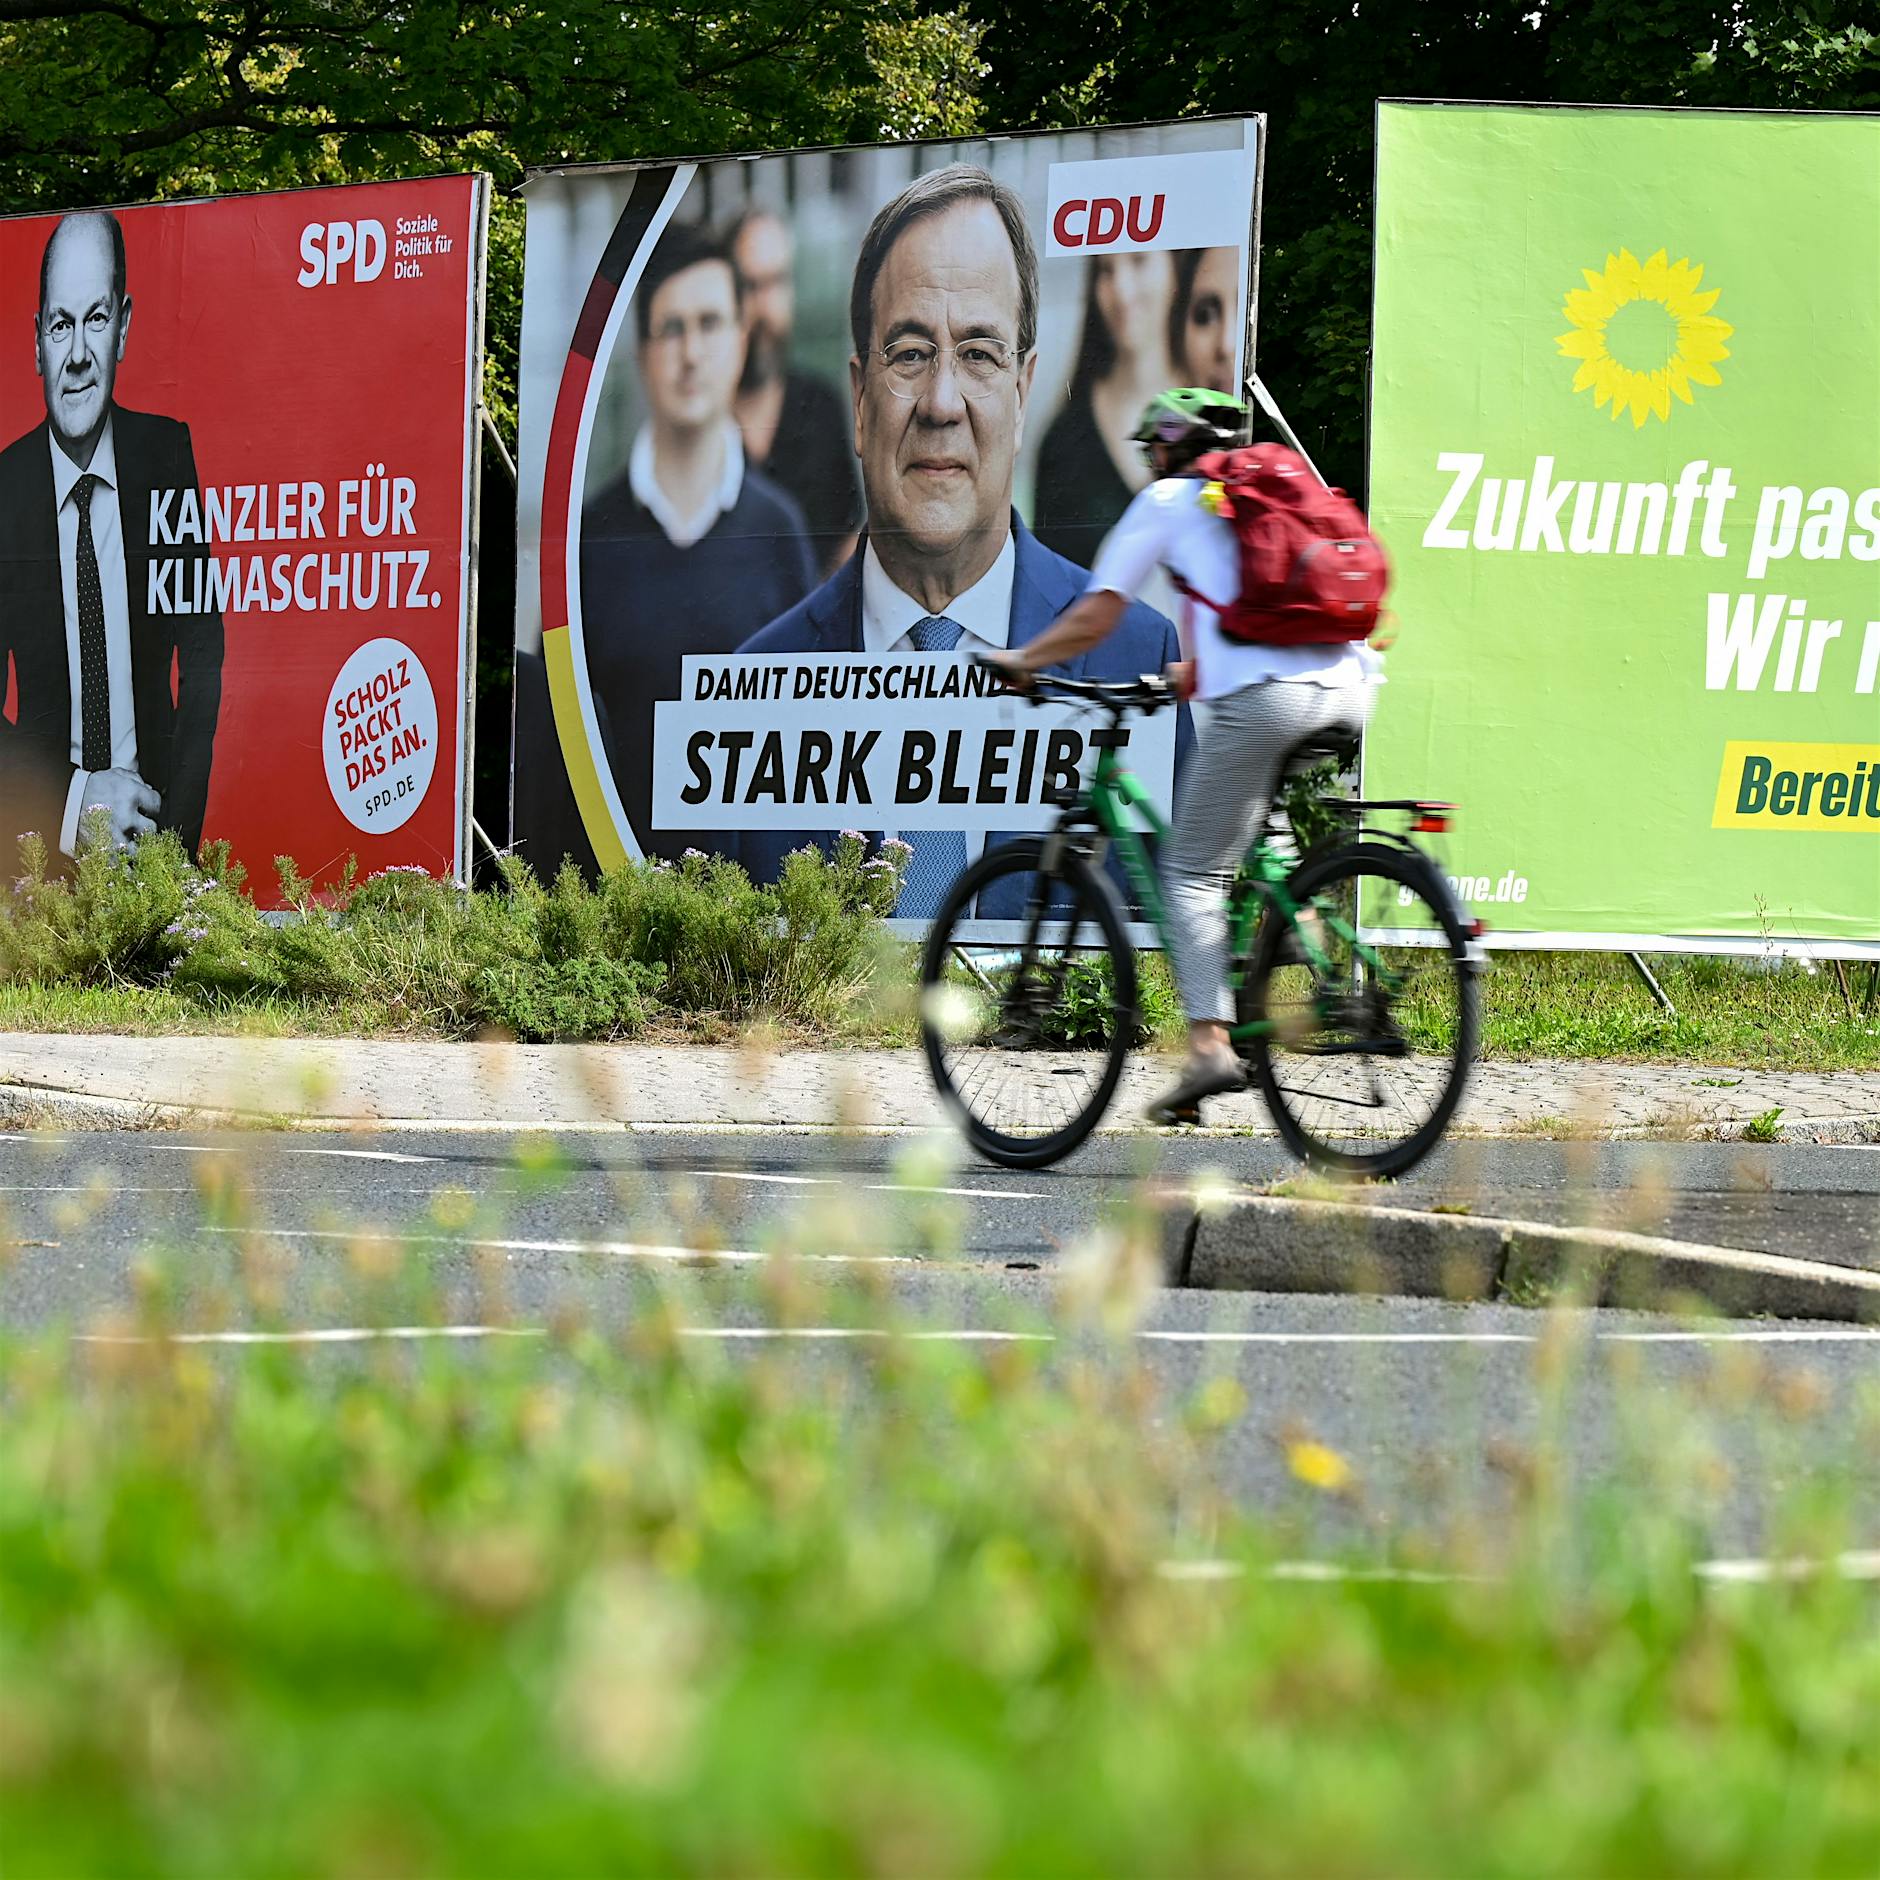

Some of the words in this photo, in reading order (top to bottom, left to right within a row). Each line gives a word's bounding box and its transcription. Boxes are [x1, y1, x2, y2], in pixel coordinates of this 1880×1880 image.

[297, 219, 387, 288] SPD
[395, 235, 432, 257] Politik
[434, 234, 453, 253] für
[396, 213, 438, 235] Soziale
[1053, 194, 1166, 248] CDU
[394, 259, 423, 280] Dich.
[148, 482, 326, 545] KANZLER
[337, 462, 417, 538] FÜR
[1422, 452, 1737, 557] Zukunft
[147, 550, 442, 615] KLIMASCHUTZ.
[1706, 592, 1842, 693] Wir
[334, 658, 411, 729] SCHOLZ
[695, 666, 788, 700] DAMIT
[339, 698, 401, 760] PACKT
[345, 745, 387, 792] DAS
[391, 723, 427, 765] AN.
[365, 775, 415, 817] SPD.DE
[680, 730, 881, 805] STARK
